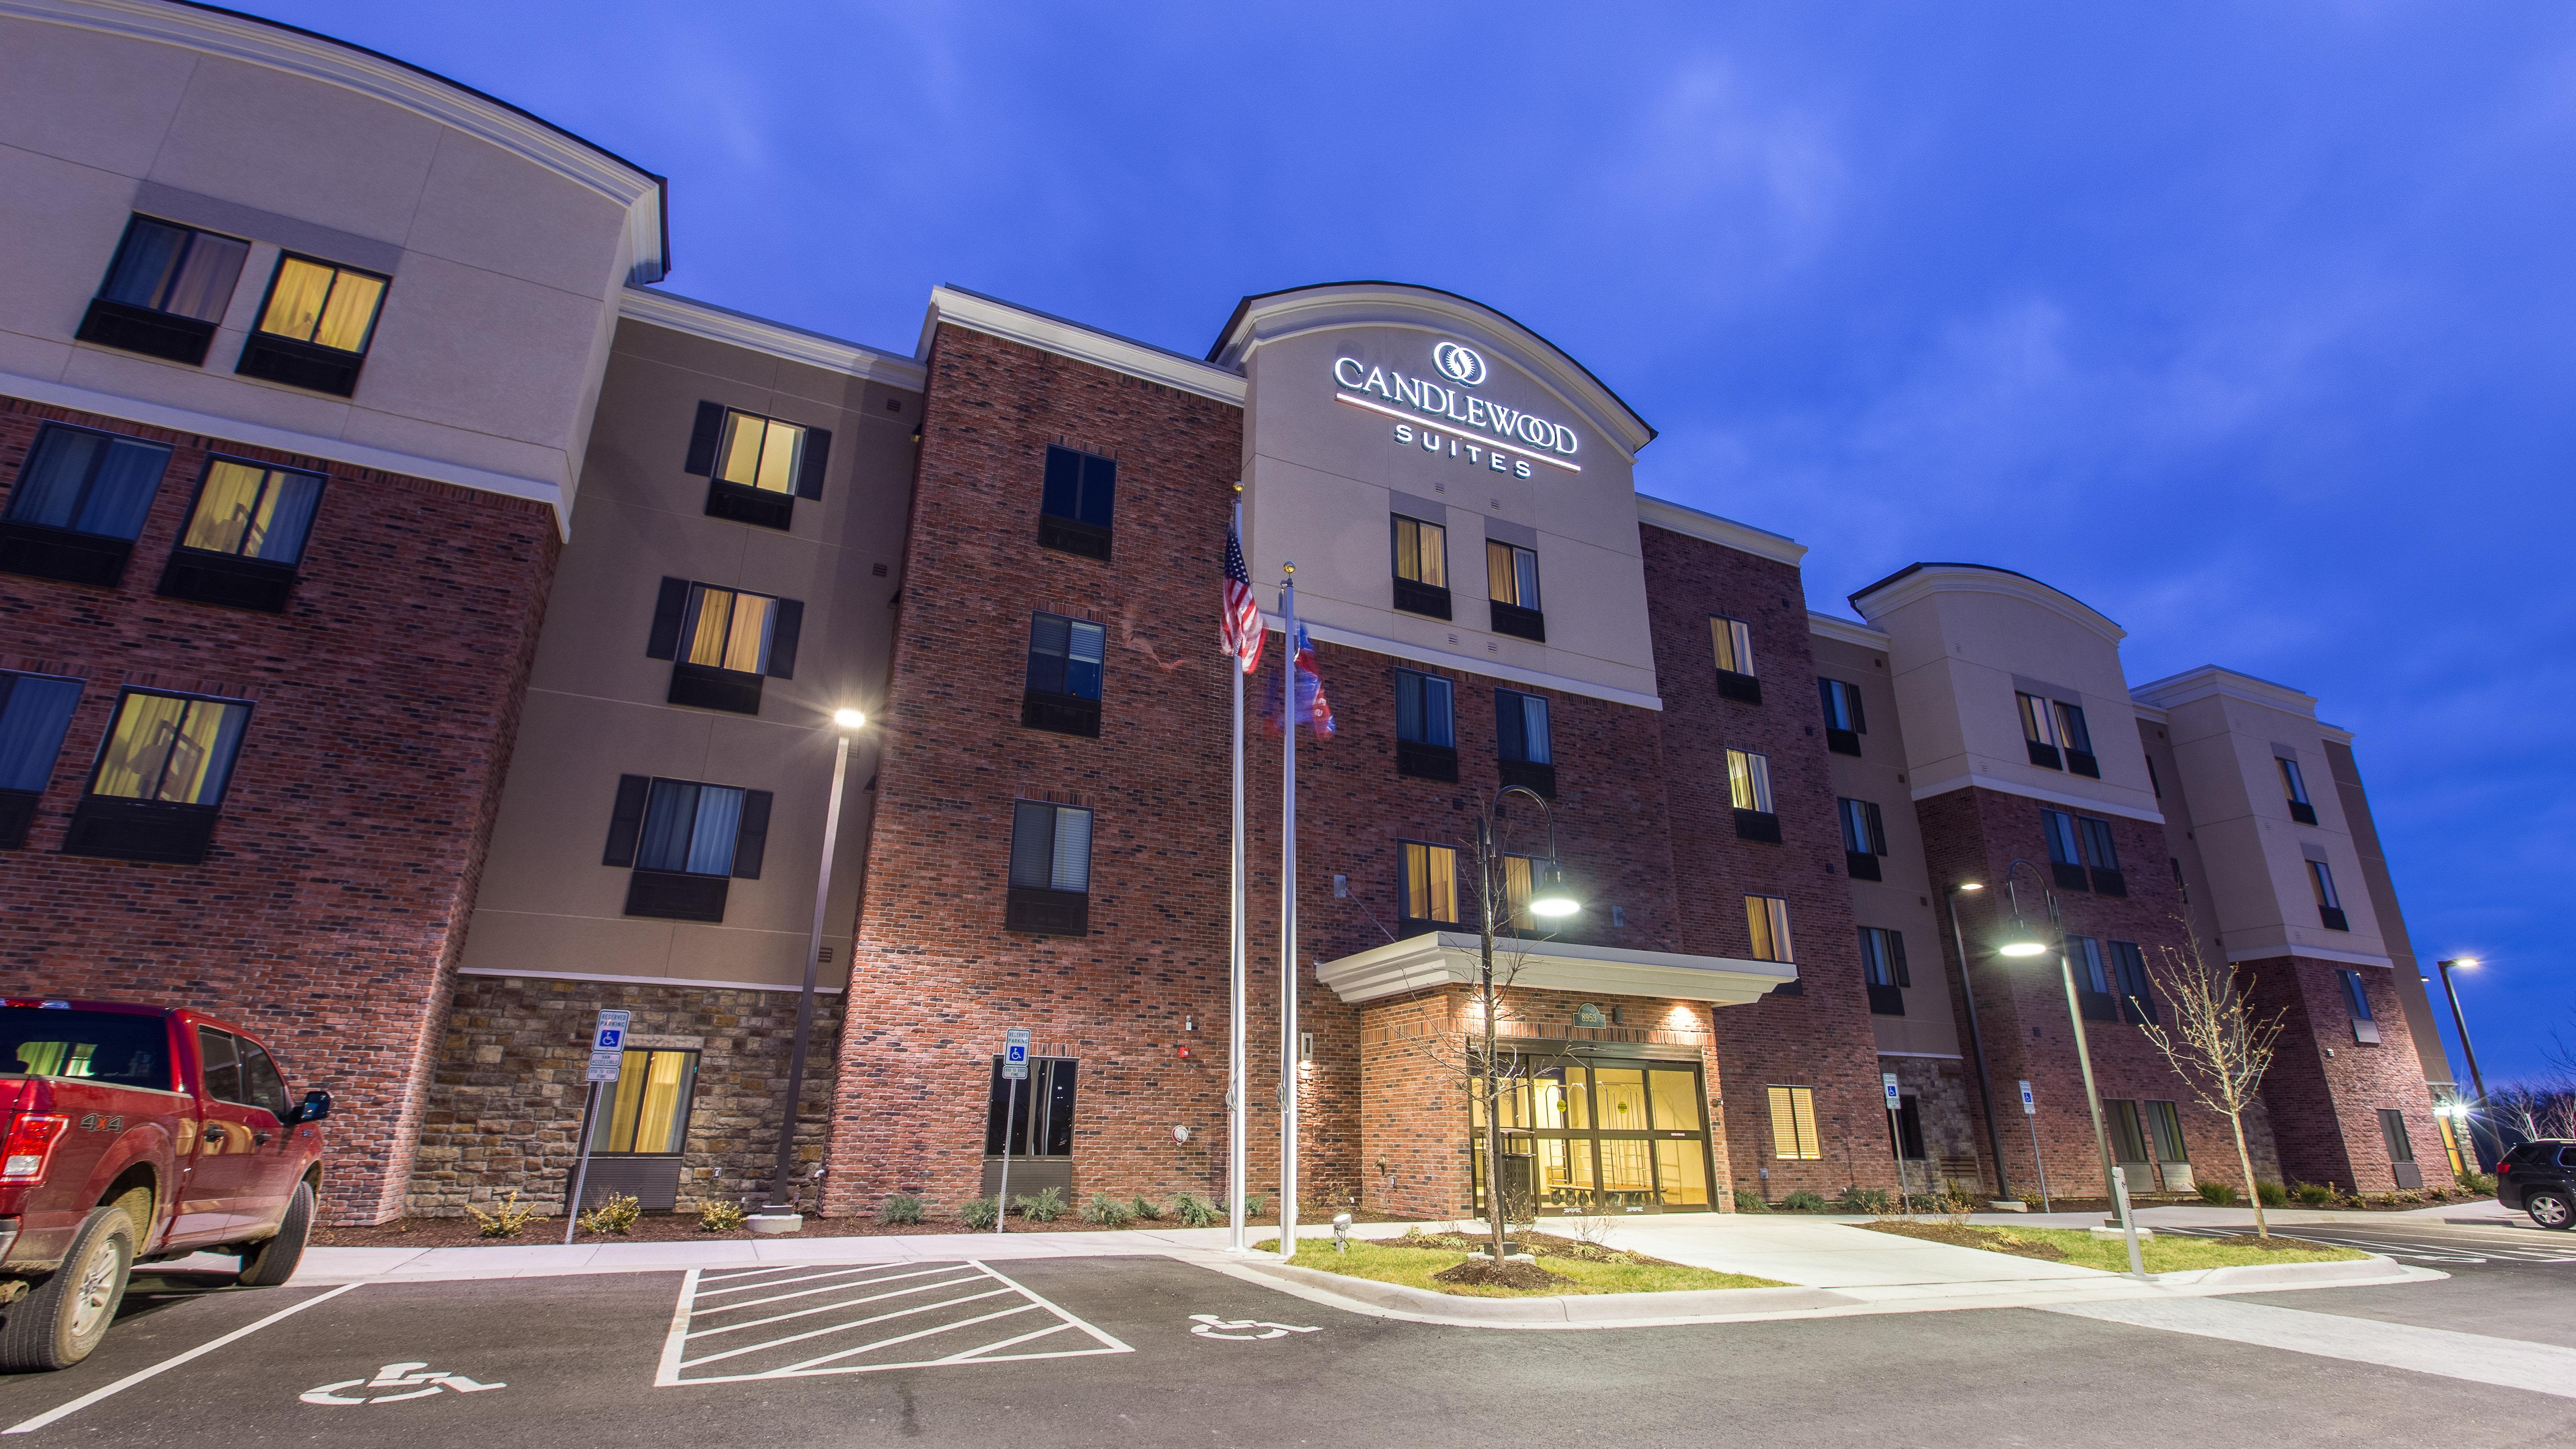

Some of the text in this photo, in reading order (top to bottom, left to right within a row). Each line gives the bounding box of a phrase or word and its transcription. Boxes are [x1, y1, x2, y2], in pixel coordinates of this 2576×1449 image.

[1334, 357, 1578, 456] CANDLEWOOD
[1394, 424, 1531, 479] SUITES
[1581, 1013, 1597, 1022] 8953
